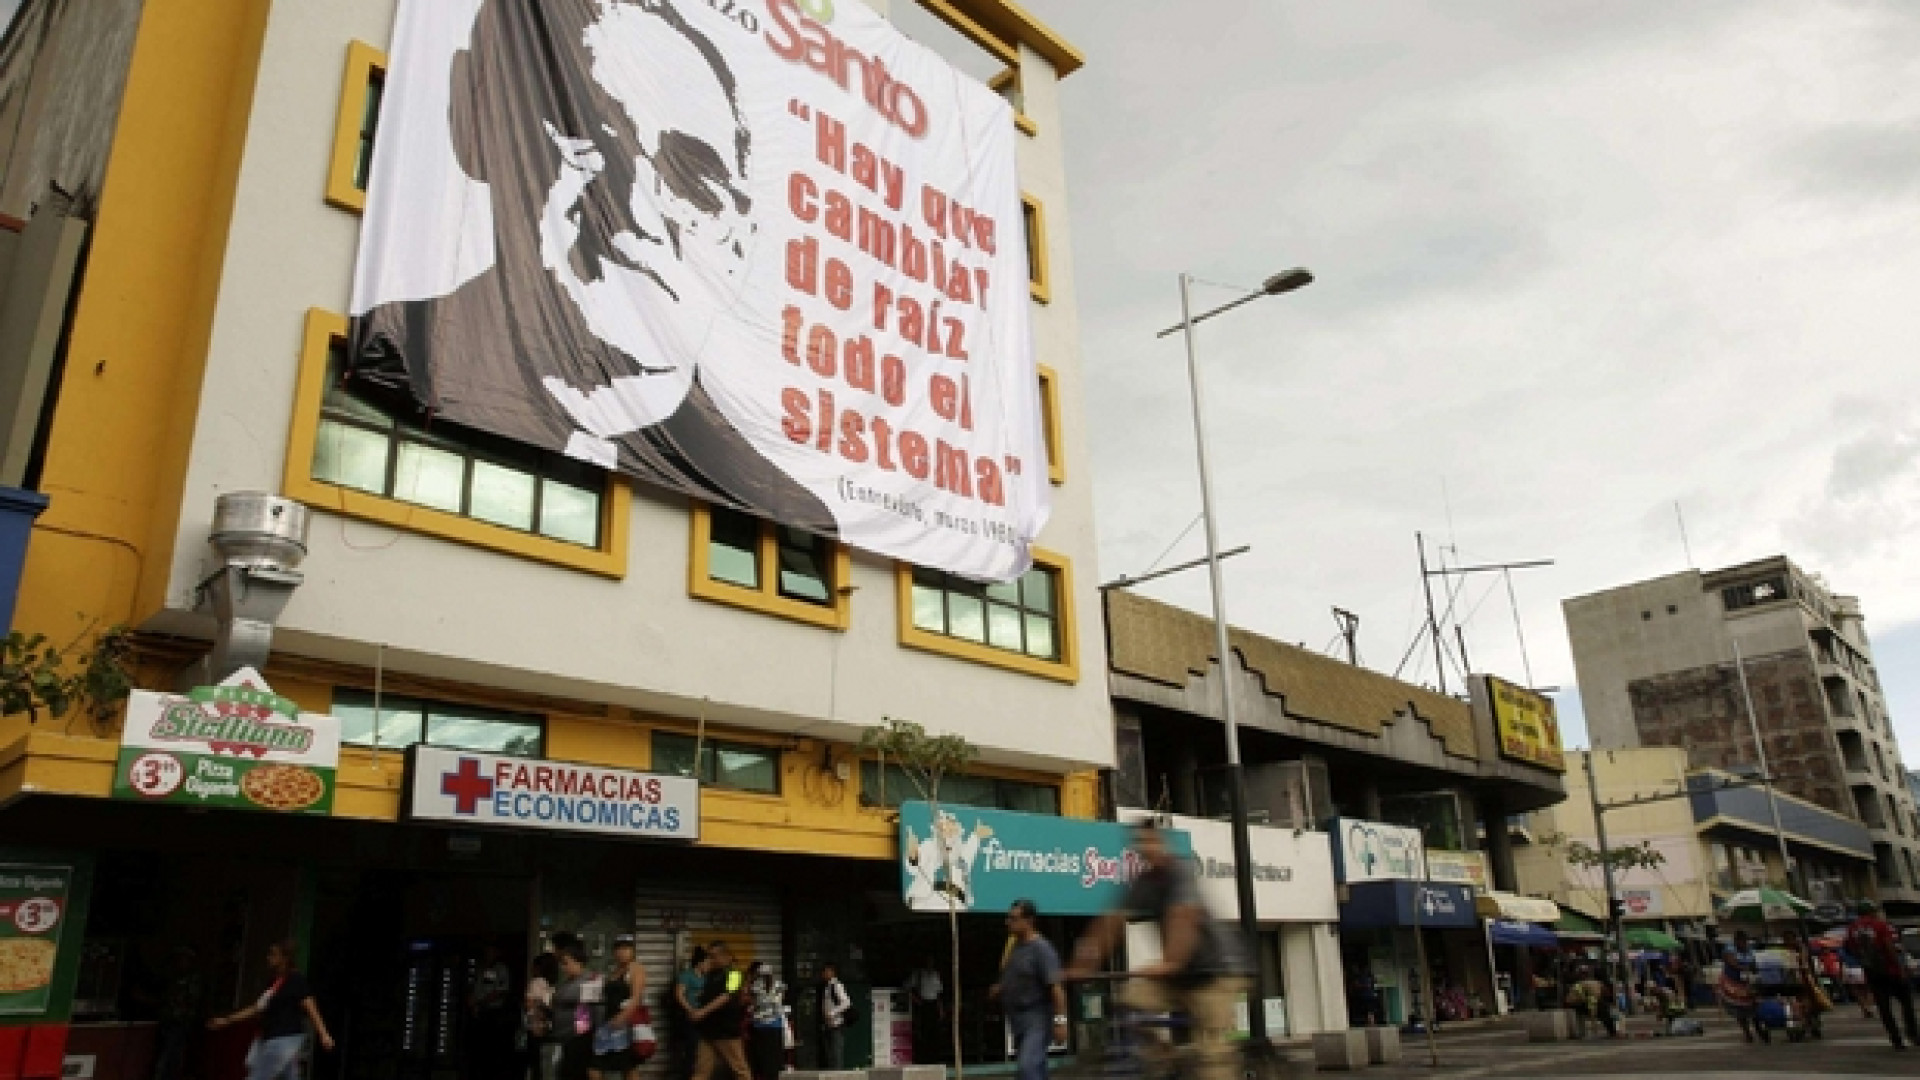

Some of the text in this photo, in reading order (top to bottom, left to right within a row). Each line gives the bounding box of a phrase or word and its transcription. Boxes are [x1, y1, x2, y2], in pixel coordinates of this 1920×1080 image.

[763, 0, 929, 138] Santo
[788, 171, 990, 310] cambiar
[921, 183, 997, 257] que
[784, 236, 854, 310] de
[781, 304, 974, 431] todo el
[492, 791, 681, 833] ECONOMICAS
[494, 760, 663, 805] FARMACIAS
[982, 837, 1081, 875] farmacias
